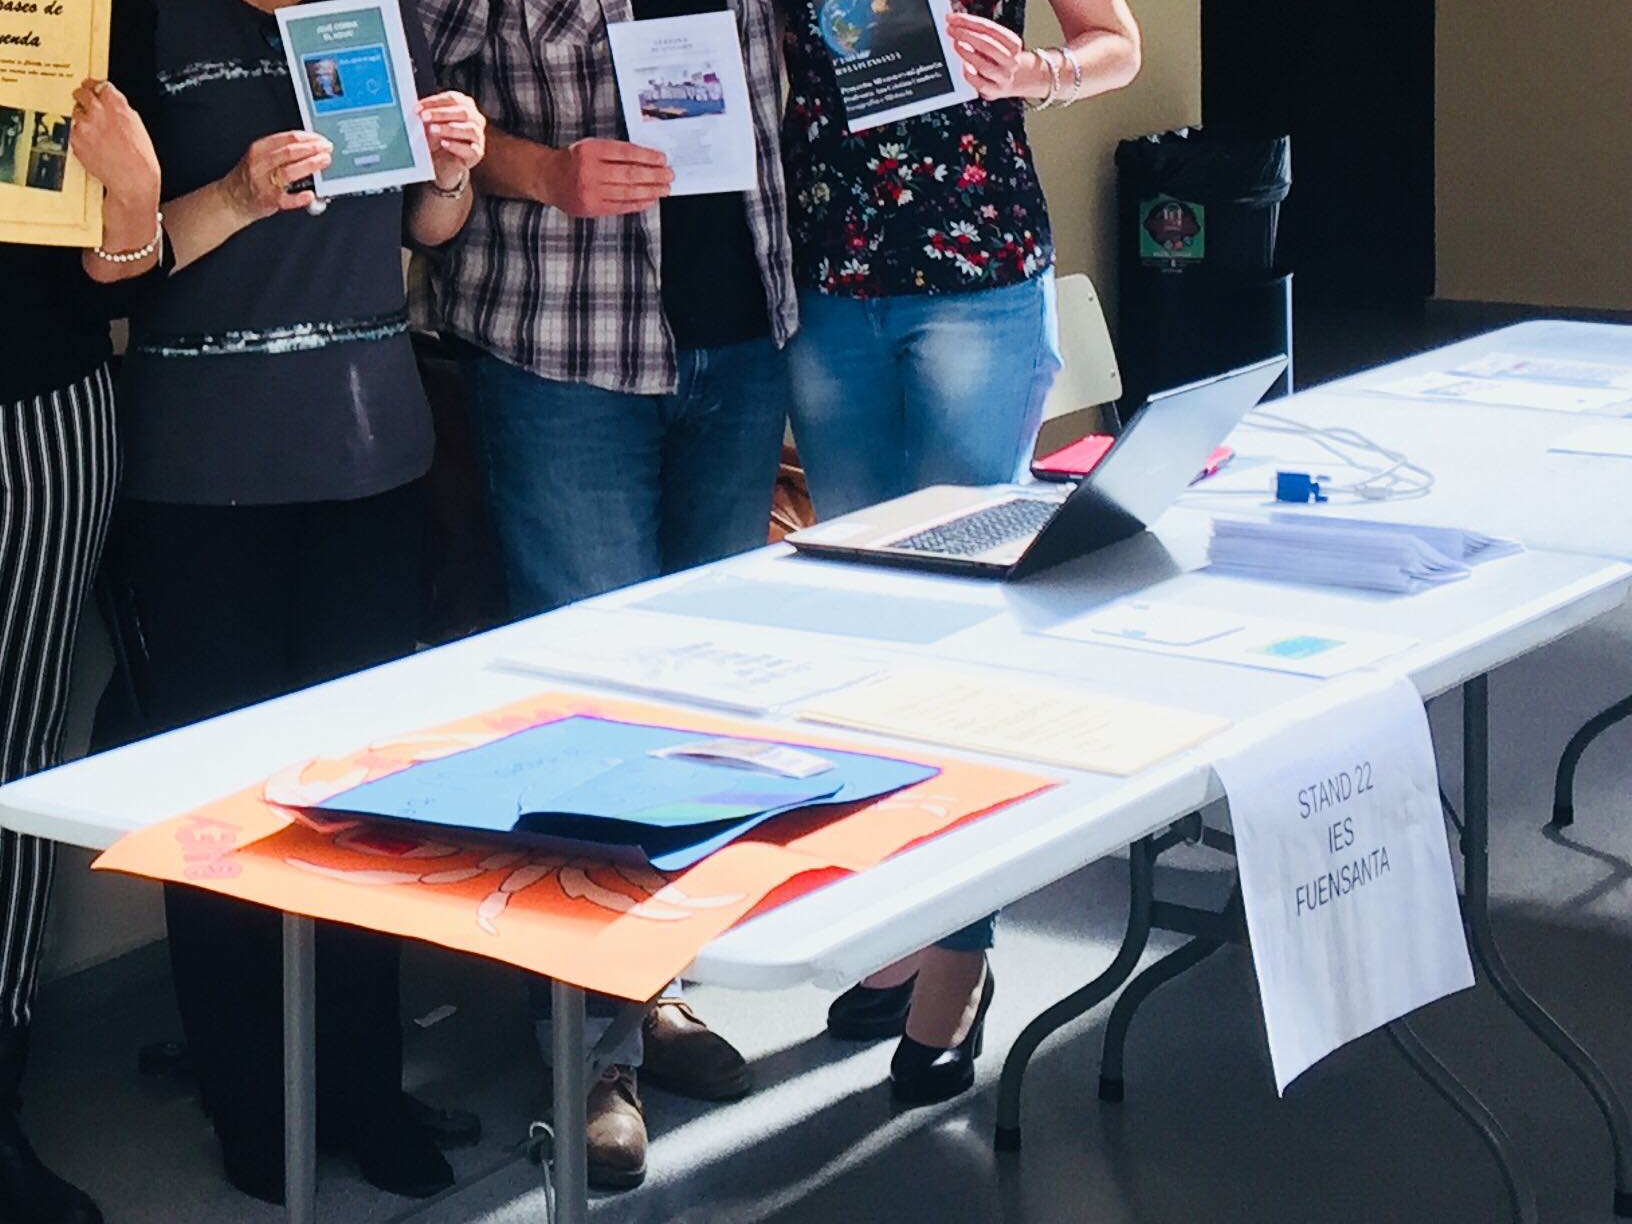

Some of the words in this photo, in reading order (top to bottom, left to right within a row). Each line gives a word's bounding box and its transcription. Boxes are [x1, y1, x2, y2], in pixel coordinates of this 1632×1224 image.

[43, 0, 64, 17] de
[1297, 771, 1354, 821] STAND
[1355, 760, 1374, 795] 22
[1327, 816, 1355, 856] IES
[1295, 845, 1392, 919] FUENSANTA
